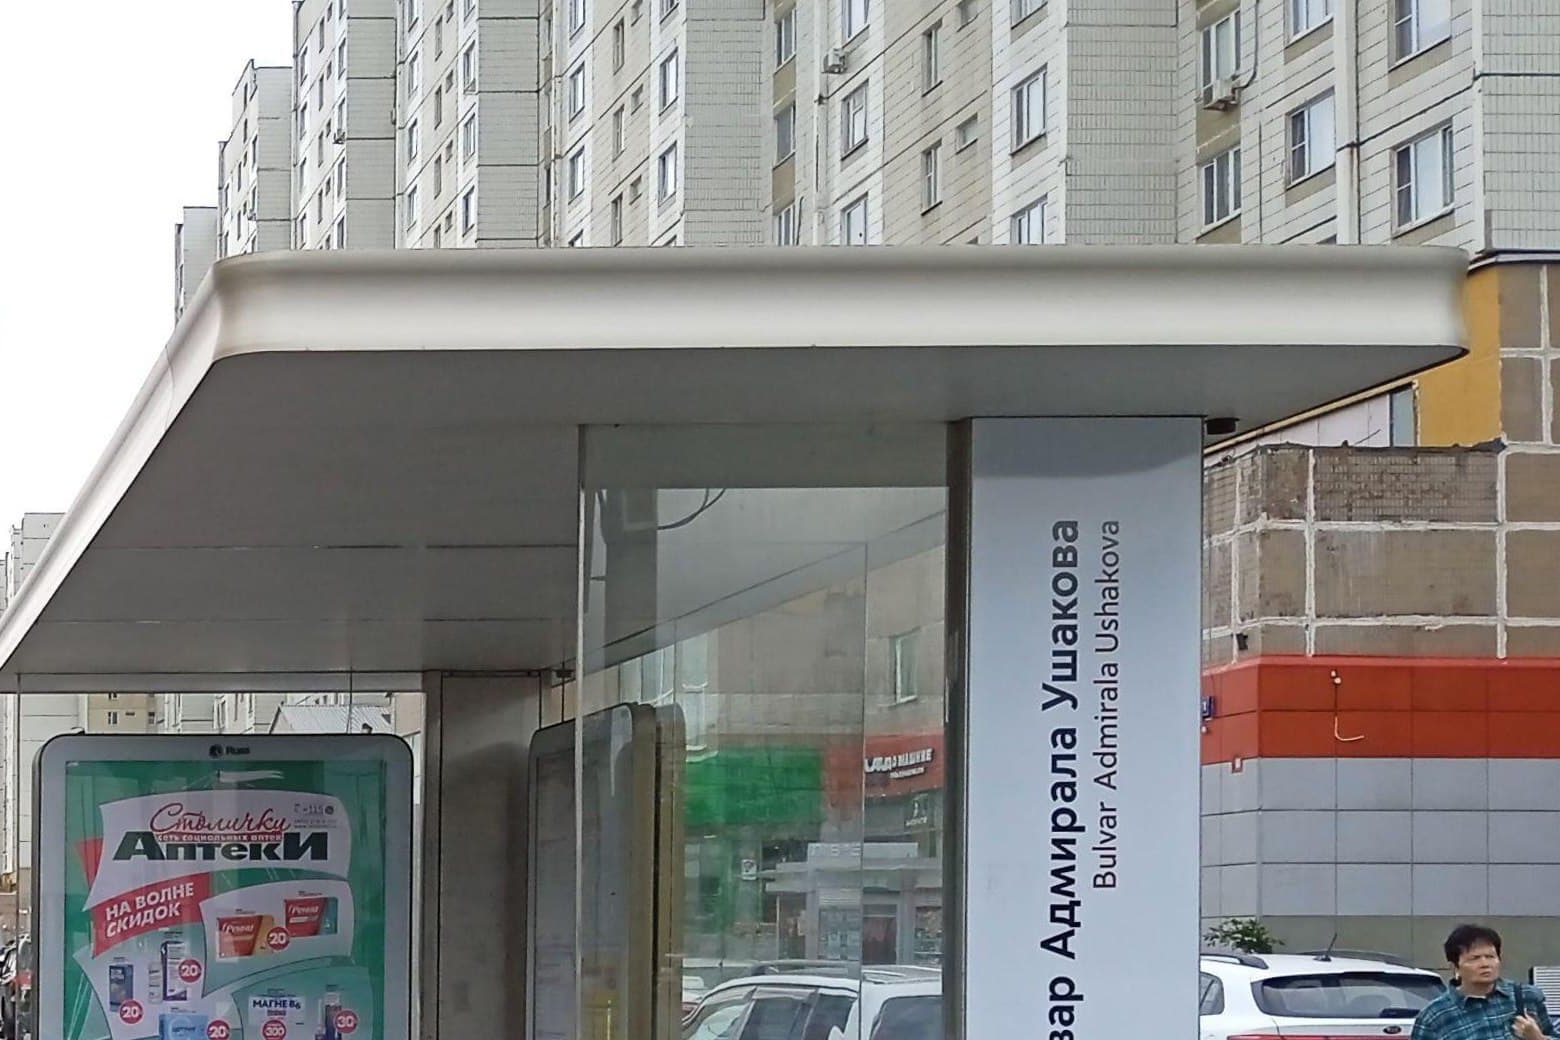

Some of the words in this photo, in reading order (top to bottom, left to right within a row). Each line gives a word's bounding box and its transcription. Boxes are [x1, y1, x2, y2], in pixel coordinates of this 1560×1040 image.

[1041, 520, 1079, 711] Ушакова
[1092, 520, 1120, 653] Ushakova
[1092, 662, 1119, 791] Admirala
[106, 901, 132, 921] НА
[135, 882, 195, 909] ВОЛНЕ
[1039, 727, 1085, 960] Адмирала
[1092, 801, 1118, 889] Bulvar
[106, 902, 181, 938] СКИДОК
